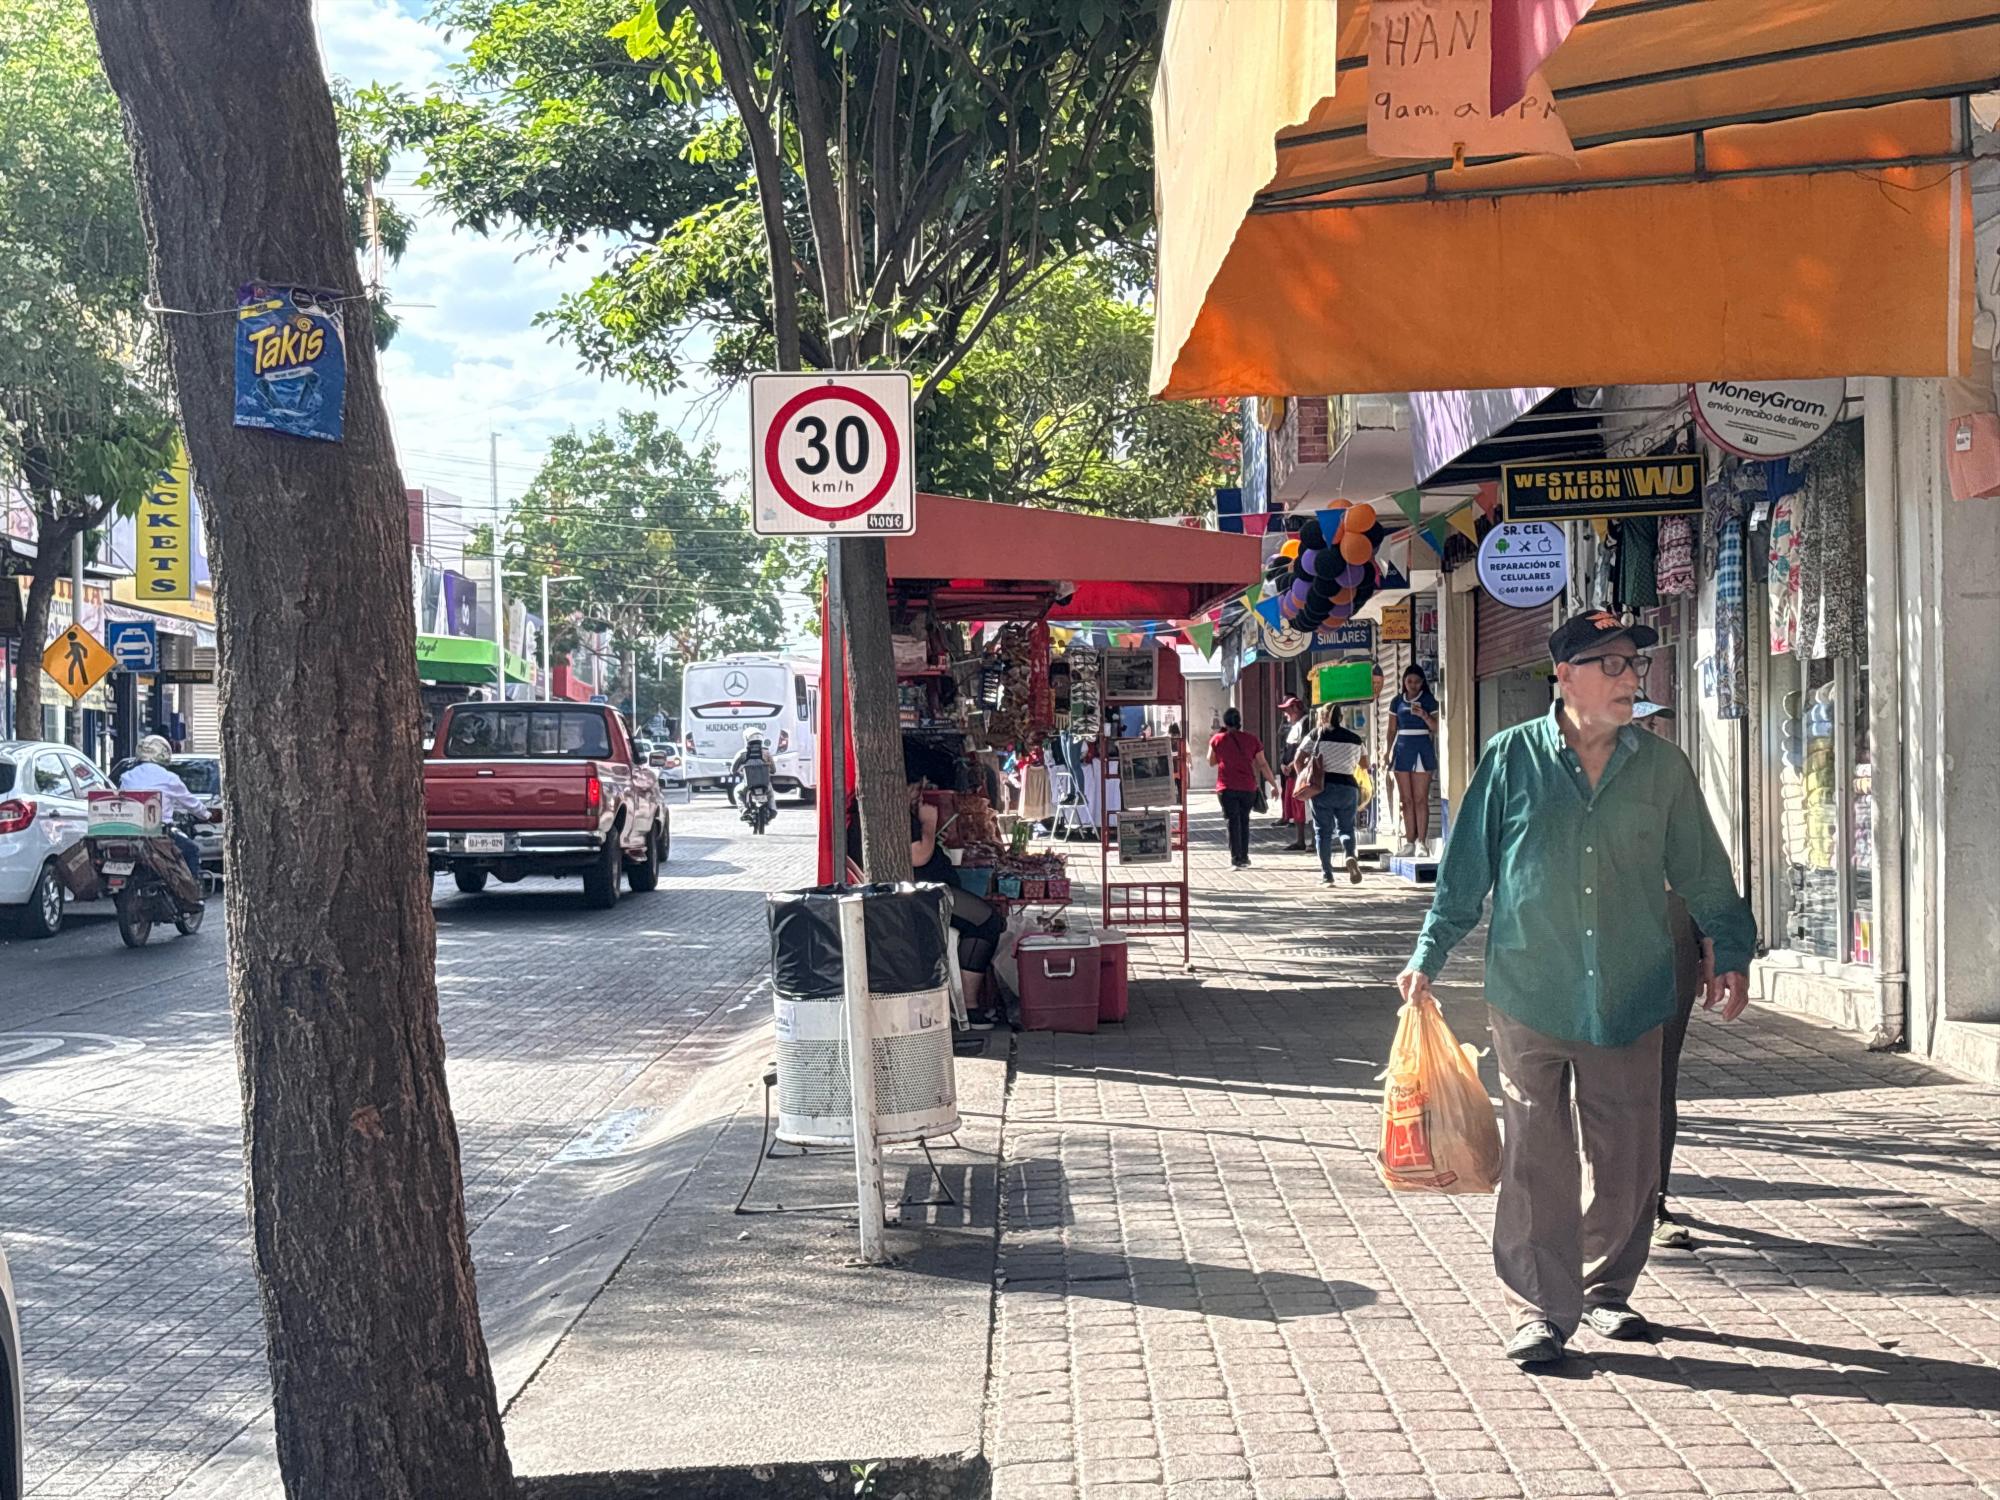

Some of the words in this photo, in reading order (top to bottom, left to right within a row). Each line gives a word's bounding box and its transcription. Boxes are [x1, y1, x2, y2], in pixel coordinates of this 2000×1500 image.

[1385, 9, 1479, 67] HAN
[1454, 102, 1480, 118] a
[248, 318, 324, 375] Takis
[1708, 381, 1825, 417] MoneyGram
[1734, 406, 1742, 415] y
[1741, 408, 1773, 421] recibo
[1773, 413, 1789, 425] de
[1789, 417, 1820, 431] dinero
[795, 415, 870, 475] 30
[812, 480, 854, 493] km/h
[1514, 468, 1620, 488] WESTERN
[1632, 464, 1694, 496] WU
[1549, 484, 1620, 501] UNION
[1503, 525, 1521, 535] SR.
[1523, 524, 1546, 534] CEL
[1490, 560, 1547, 571] REPARACIÓN
[1549, 560, 1561, 568] DE
[1500, 572, 1551, 581] CELULARES
[1317, 631, 1367, 645] SIMILARES
[450, 788, 559, 806] ORD
